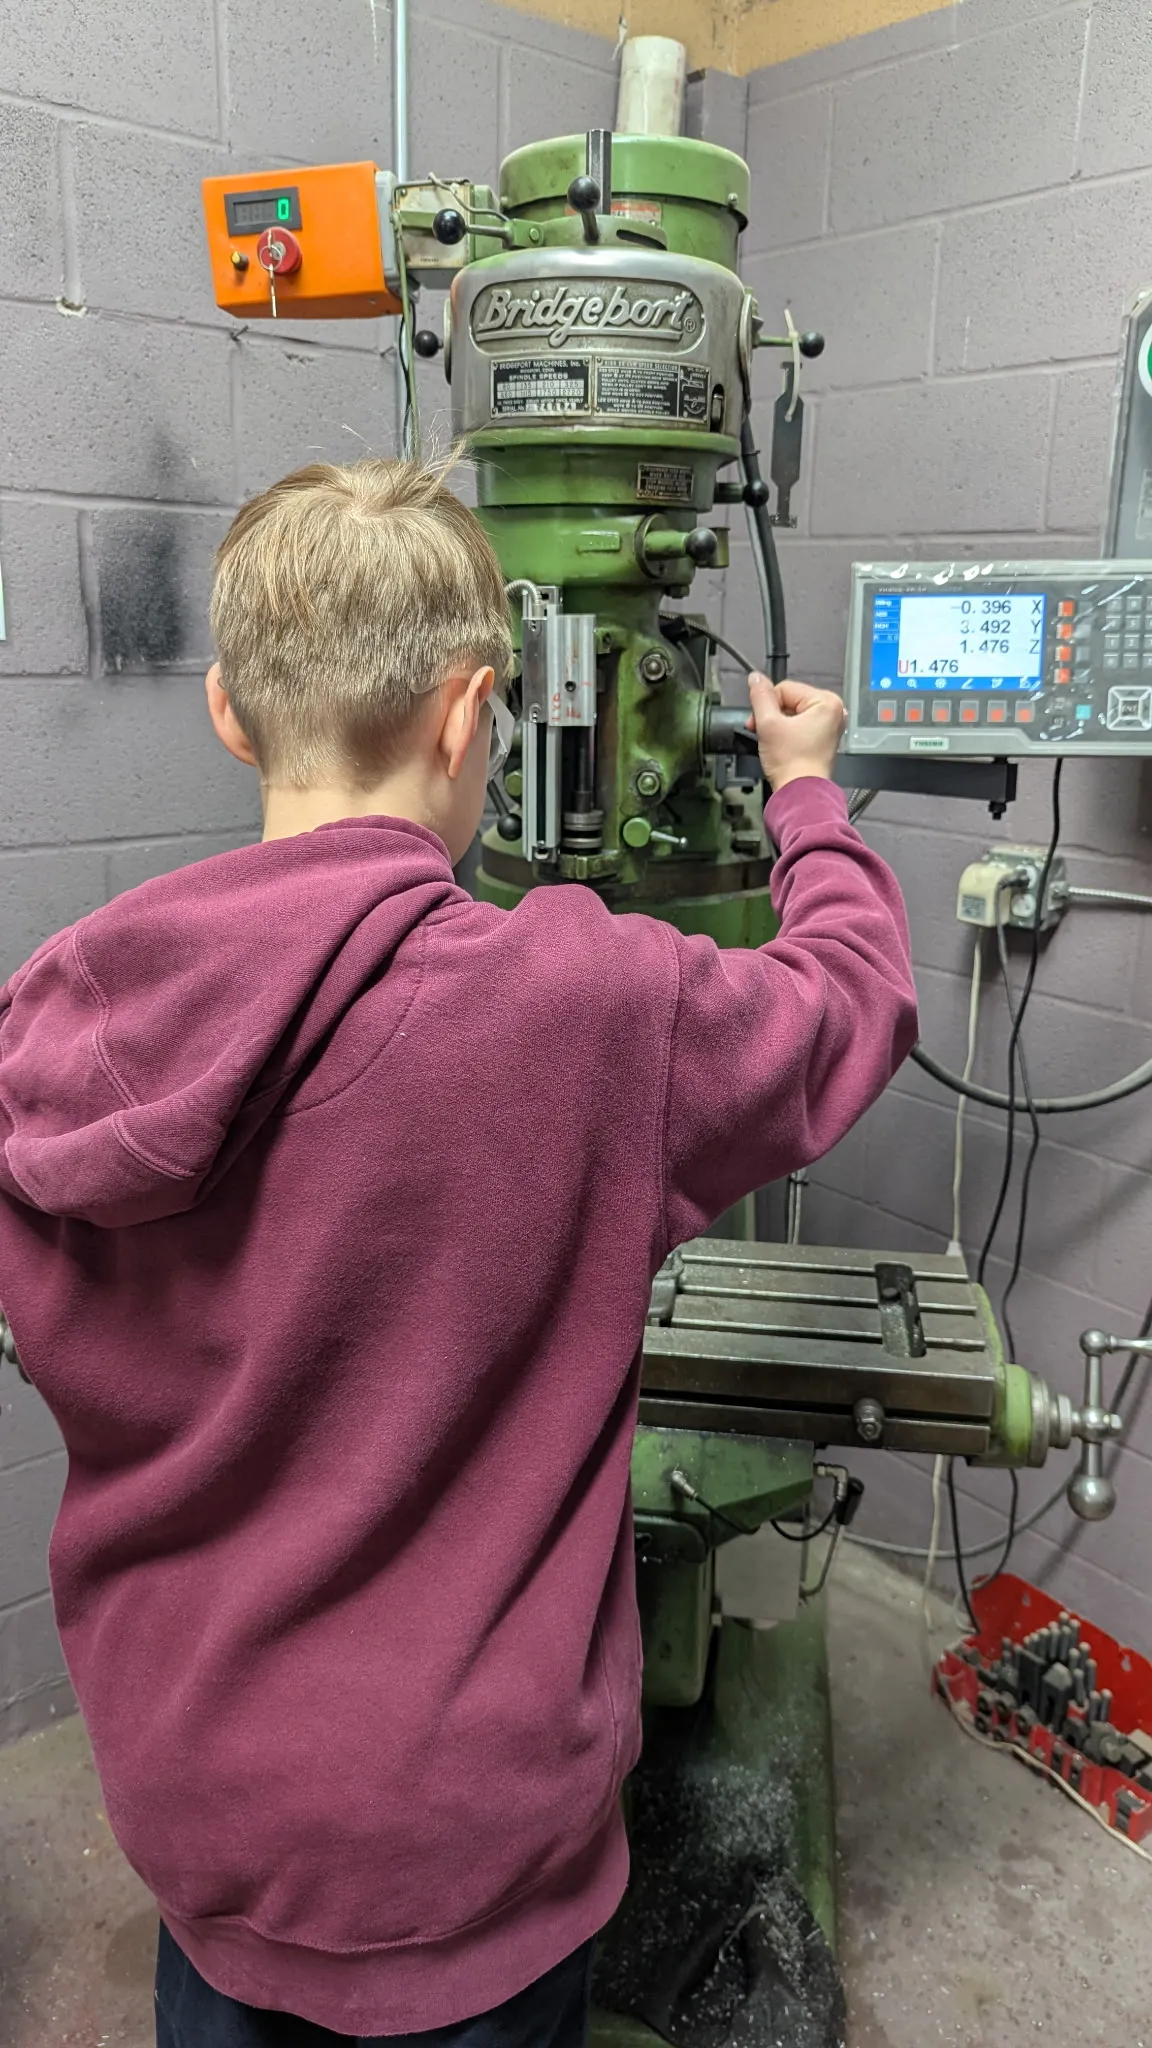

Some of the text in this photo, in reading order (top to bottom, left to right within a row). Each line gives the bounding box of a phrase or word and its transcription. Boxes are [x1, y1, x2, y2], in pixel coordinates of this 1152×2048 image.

[278, 198, 289, 220] 0
[478, 286, 693, 347] Bridgeport
[500, 361, 531, 370] BRIDGEPORT
[951, 600, 1012, 614] -0.396
[1032, 600, 1042, 614] X
[960, 620, 1042, 634] 3.492 Y
[960, 640, 1040, 654] 1.476 Z
